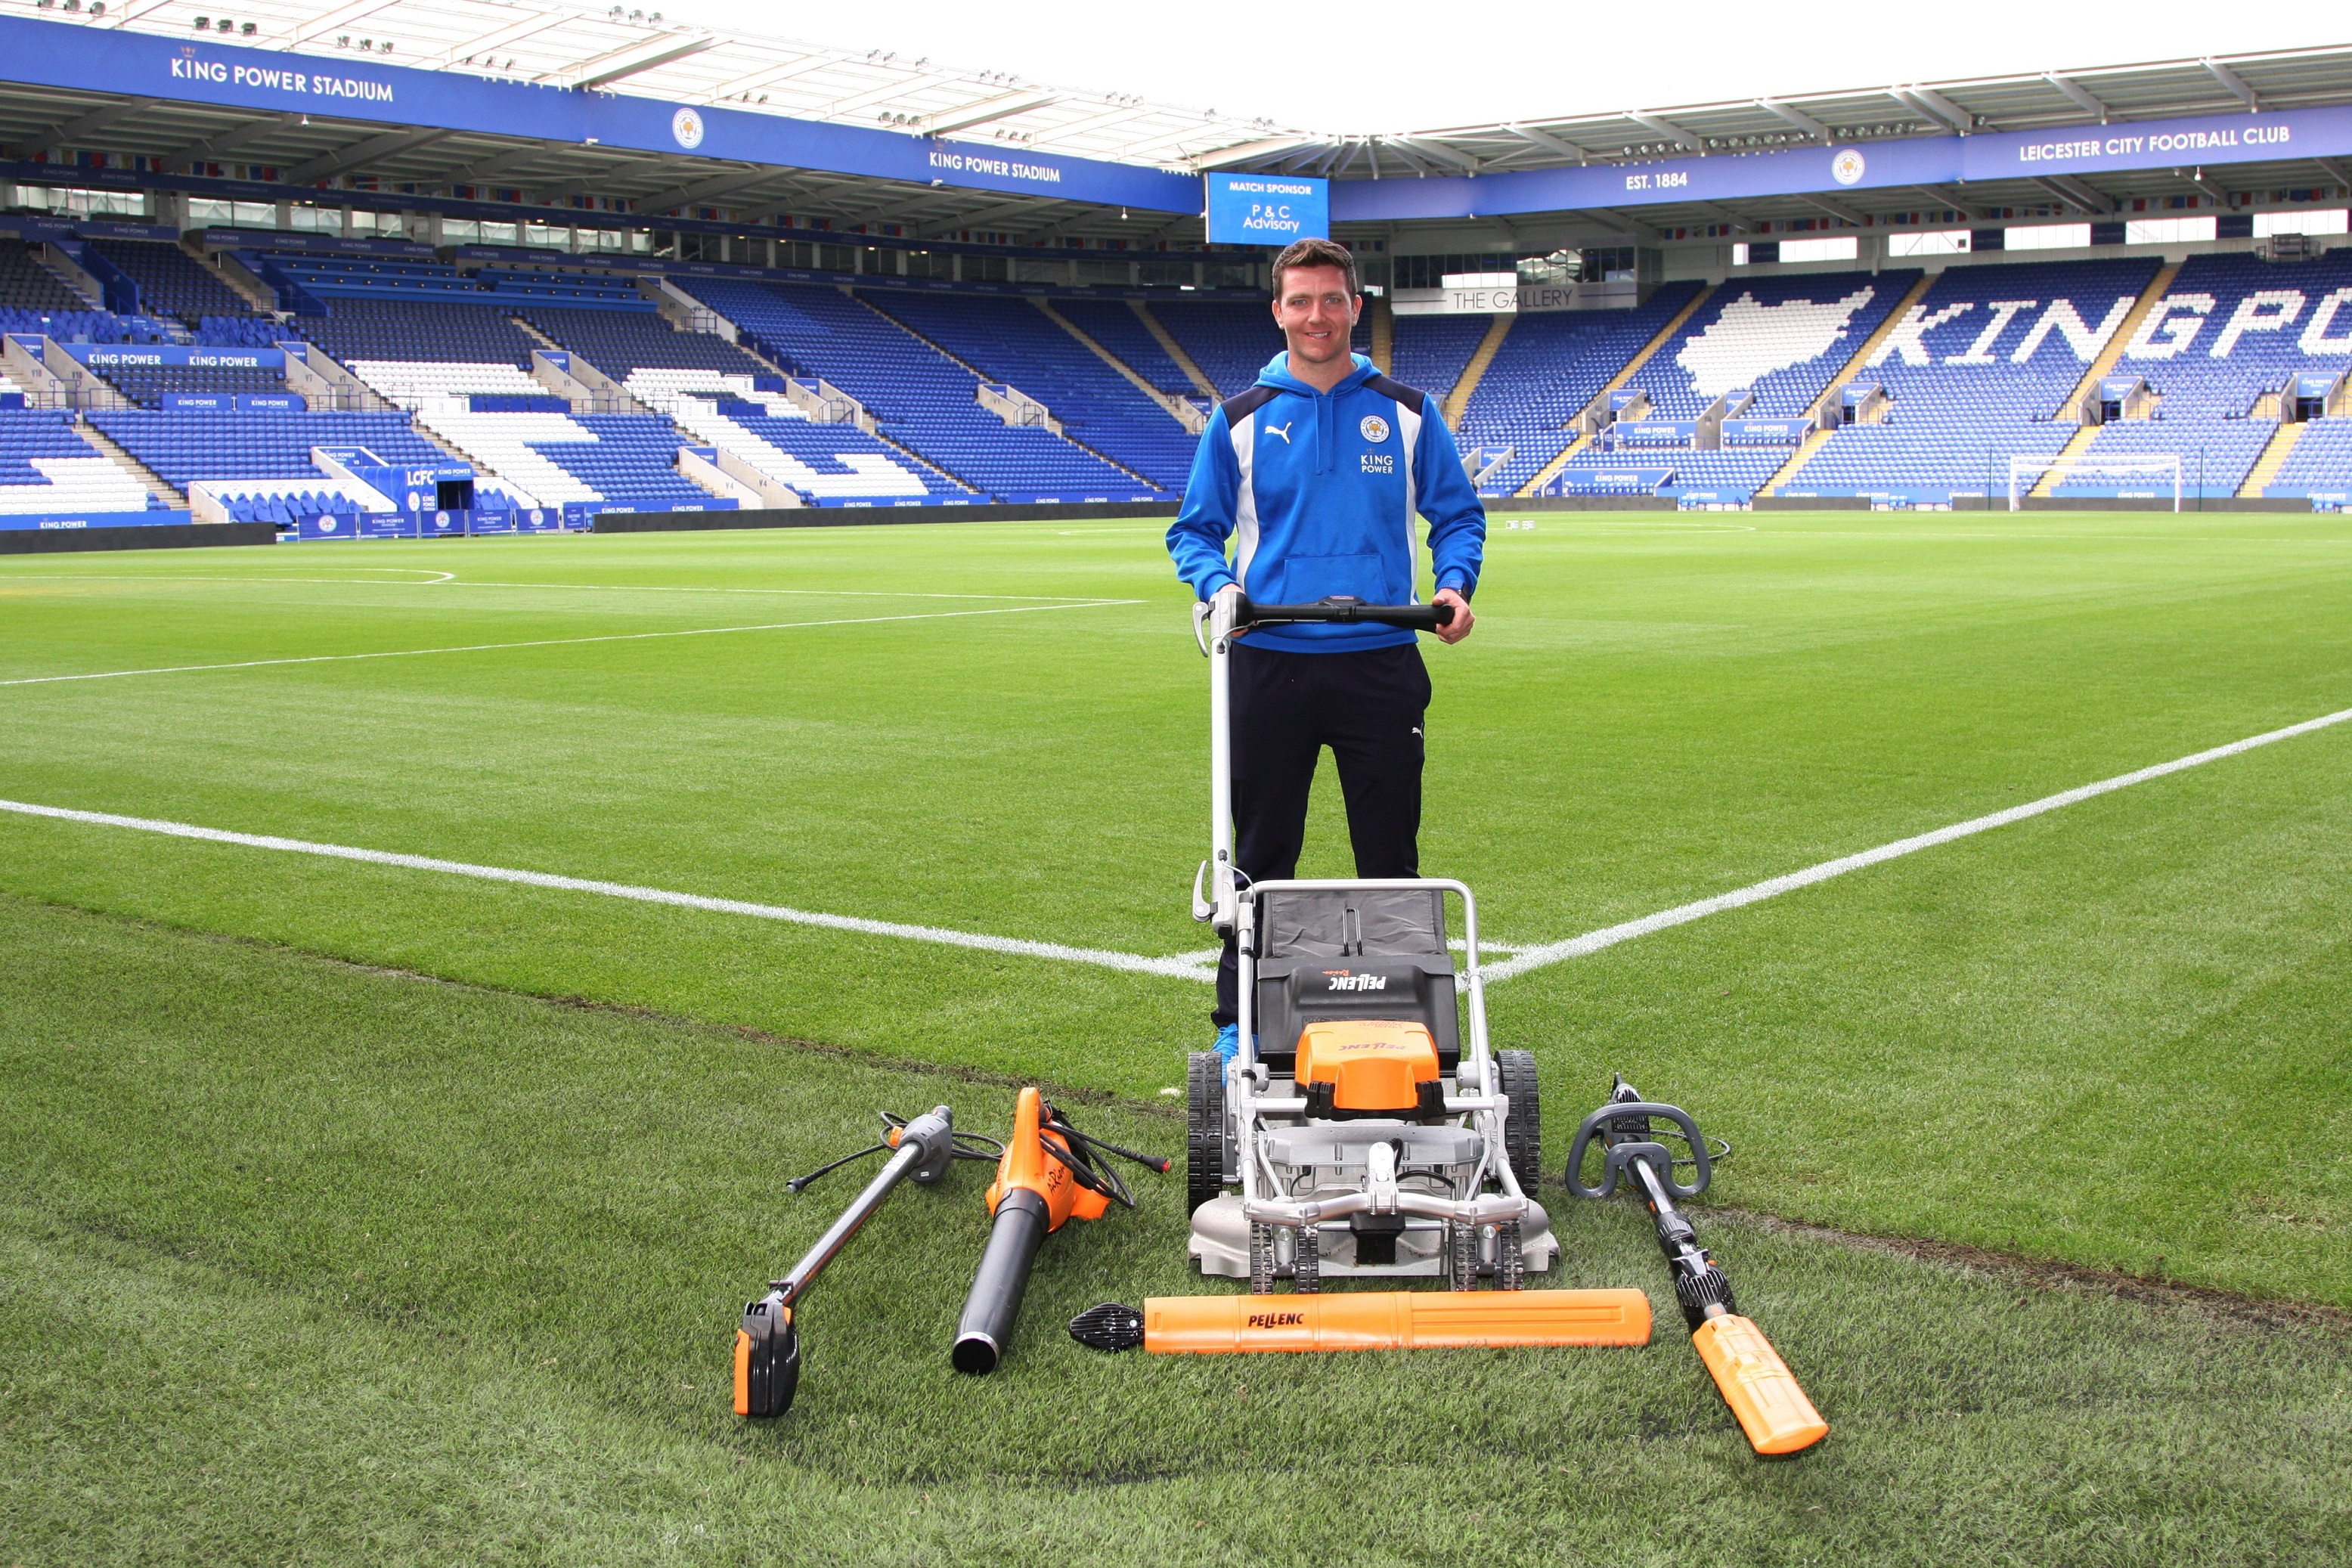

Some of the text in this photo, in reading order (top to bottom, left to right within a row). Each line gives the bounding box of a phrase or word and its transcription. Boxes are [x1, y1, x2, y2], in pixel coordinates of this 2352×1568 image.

[172, 57, 393, 102] KING POWER STADIUM
[2019, 126, 2290, 162] LEICESTER CITY FOOTBALL CLUB
[929, 151, 1060, 182] KING POWER STADIUM
[1229, 181, 1312, 195] MATCH SPONSOR
[1626, 172, 1687, 191] EST. 1884
[1252, 204, 1290, 218] P & C
[1243, 216, 1300, 234] Advisory
[1453, 289, 1573, 309] THE GALLERY
[88, 354, 161, 365] KING POWER
[189, 356, 258, 367] KING POWER
[1361, 454, 1393, 466] KING
[1362, 465, 1393, 474] POWER
[407, 470, 435, 486] LCFC
[759, 479, 767, 488] V4
[61, 520, 87, 528] POWER
[1328, 974, 1387, 992] PELLENC
[1338, 1043, 1406, 1051] PELLENC
[1247, 1312, 1305, 1329] PELLENC
